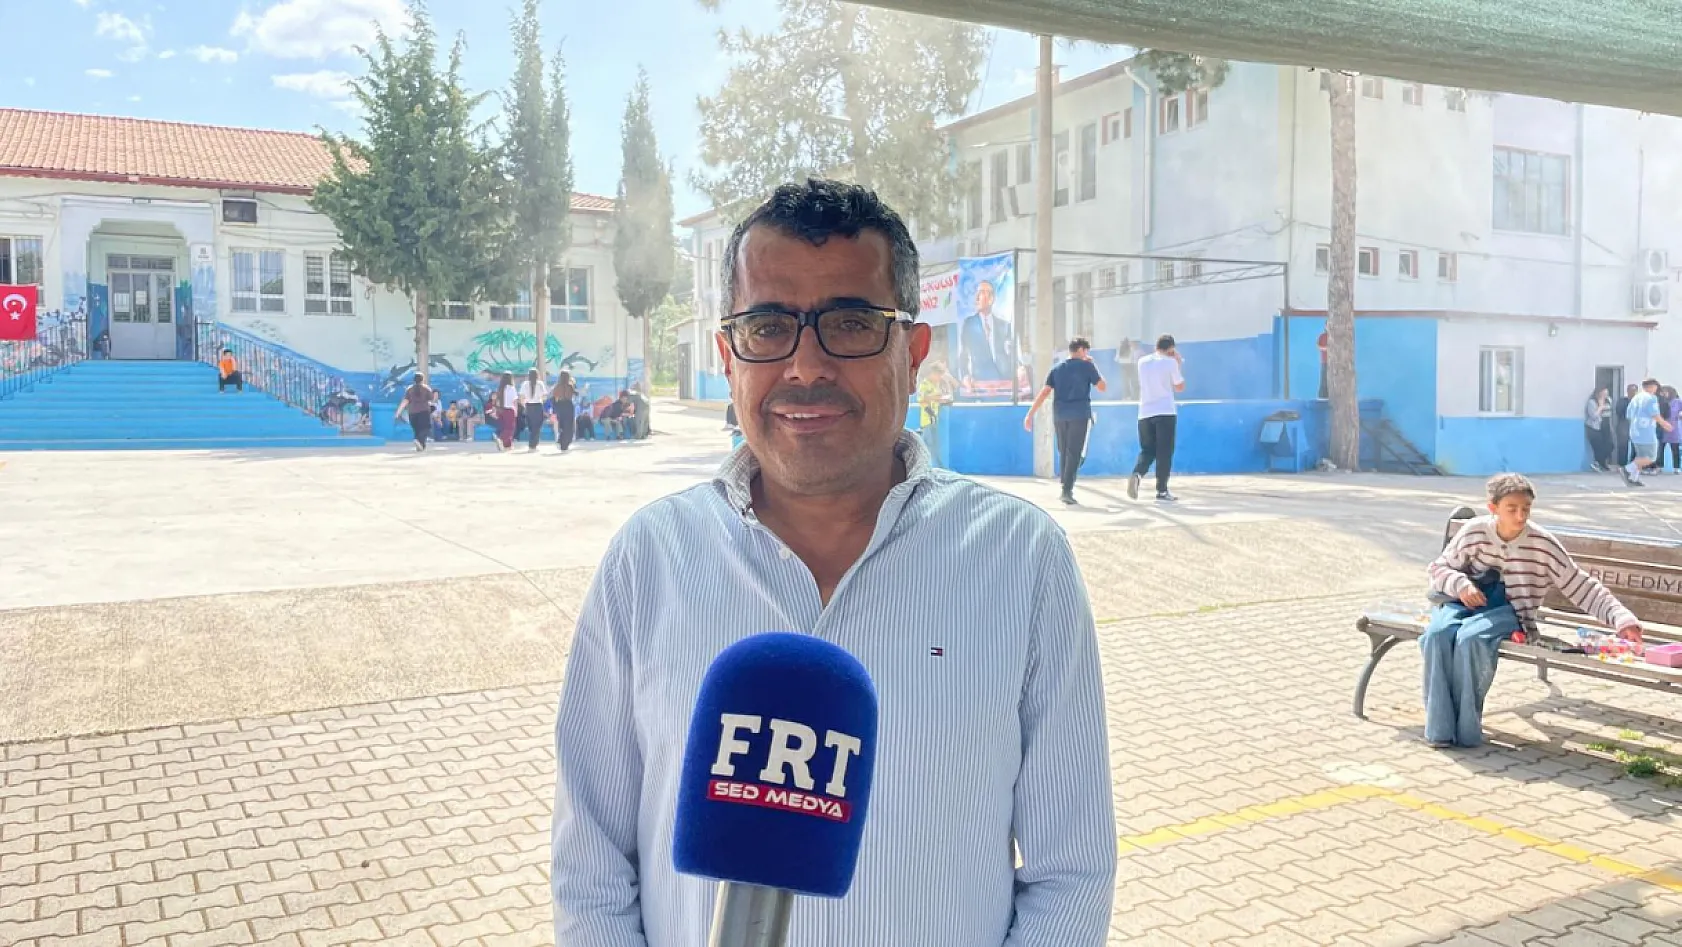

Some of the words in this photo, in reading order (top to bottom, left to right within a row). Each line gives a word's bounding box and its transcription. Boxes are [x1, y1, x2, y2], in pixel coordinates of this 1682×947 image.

[710, 713, 862, 798] FRT
[714, 782, 760, 800] SED
[764, 789, 844, 818] MEDYA
